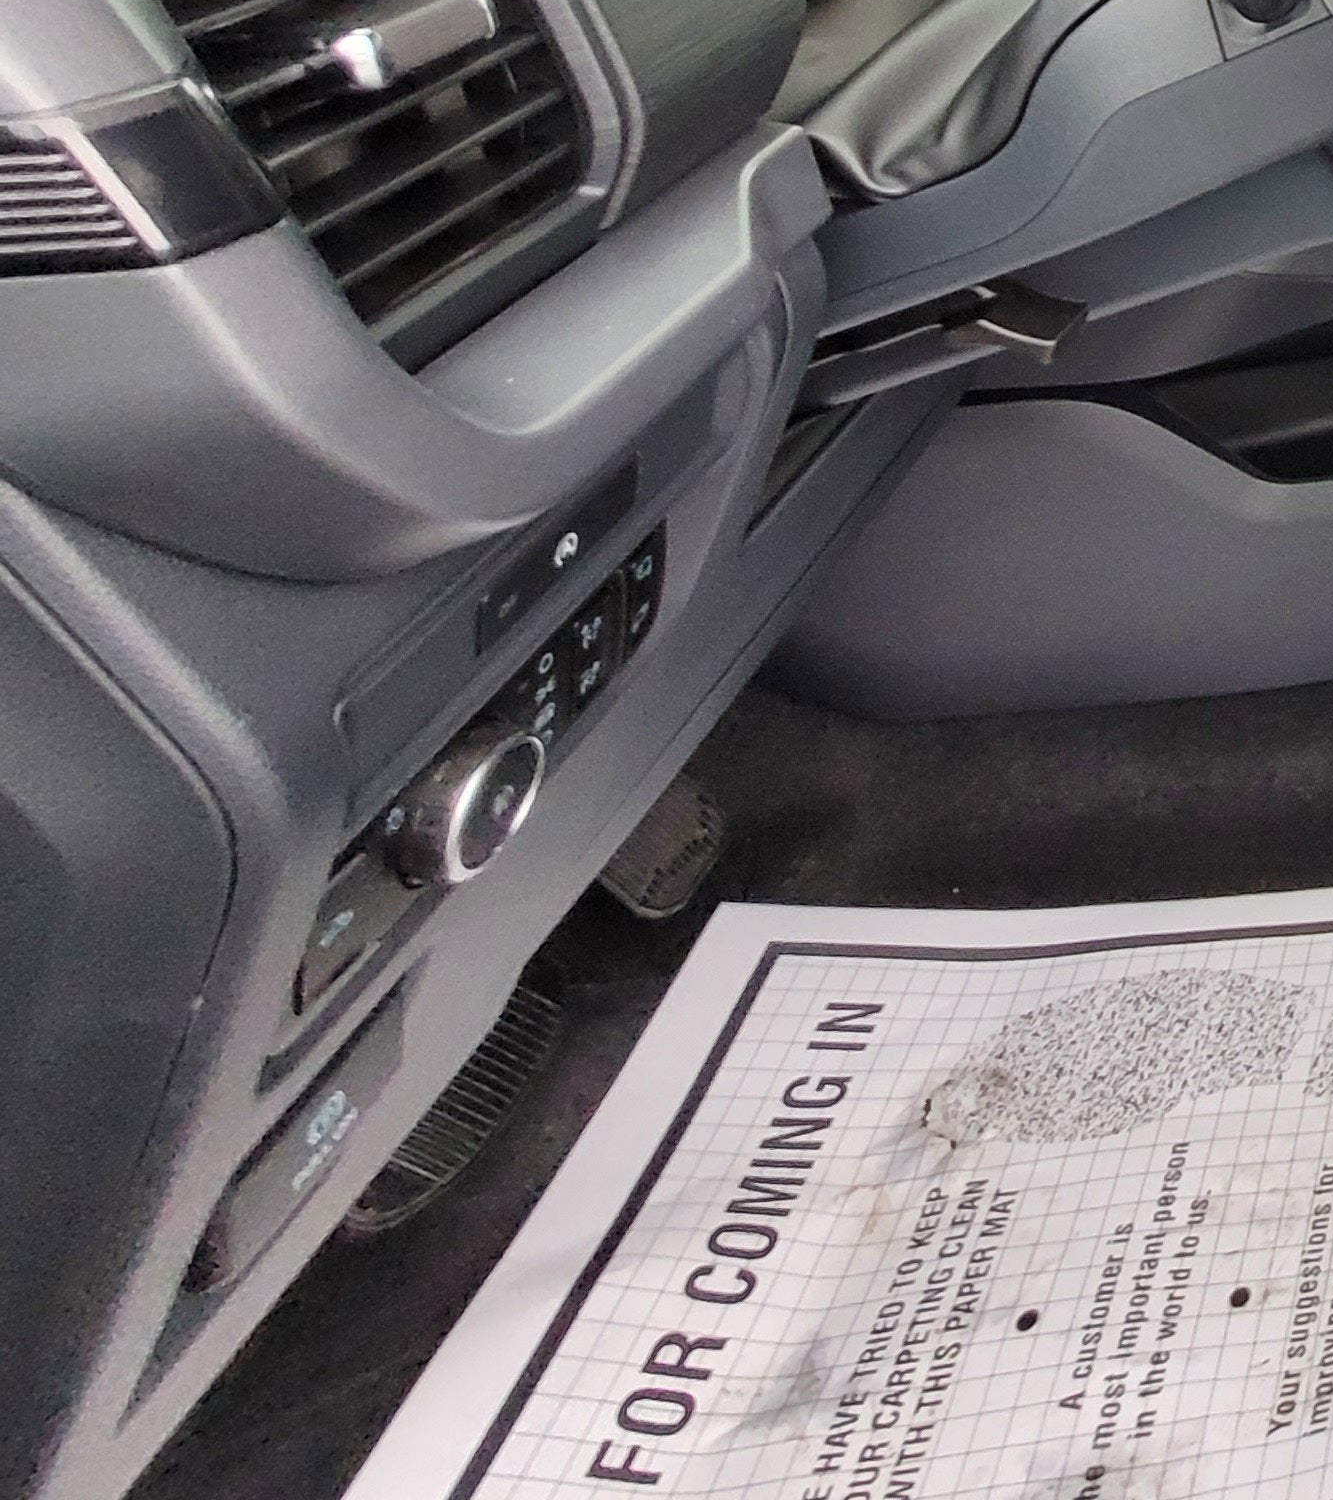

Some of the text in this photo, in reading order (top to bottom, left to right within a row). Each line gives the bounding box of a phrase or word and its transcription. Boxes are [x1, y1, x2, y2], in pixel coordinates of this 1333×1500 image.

[586, 1002, 886, 1485] FOR COMING IN
[812, 1390, 867, 1475] HAVE
[848, 1301, 905, 1384] TRIED
[889, 1257, 925, 1294] TO
[908, 1186, 949, 1250] KEEP
[872, 1266, 953, 1431] CARPETING
[939, 1178, 990, 1260] CLEAN
[913, 1342, 962, 1415] THIS
[945, 1245, 998, 1332] PAPER
[981, 1188, 1020, 1238] MAT
[1059, 1221, 1134, 1411] A customer is
[1073, 1141, 1191, 1500] he most important person
[1127, 1189, 1212, 1440] in the world to us.
[1267, 1369, 1301, 1437] Your
[1288, 1201, 1331, 1359] suggestions
